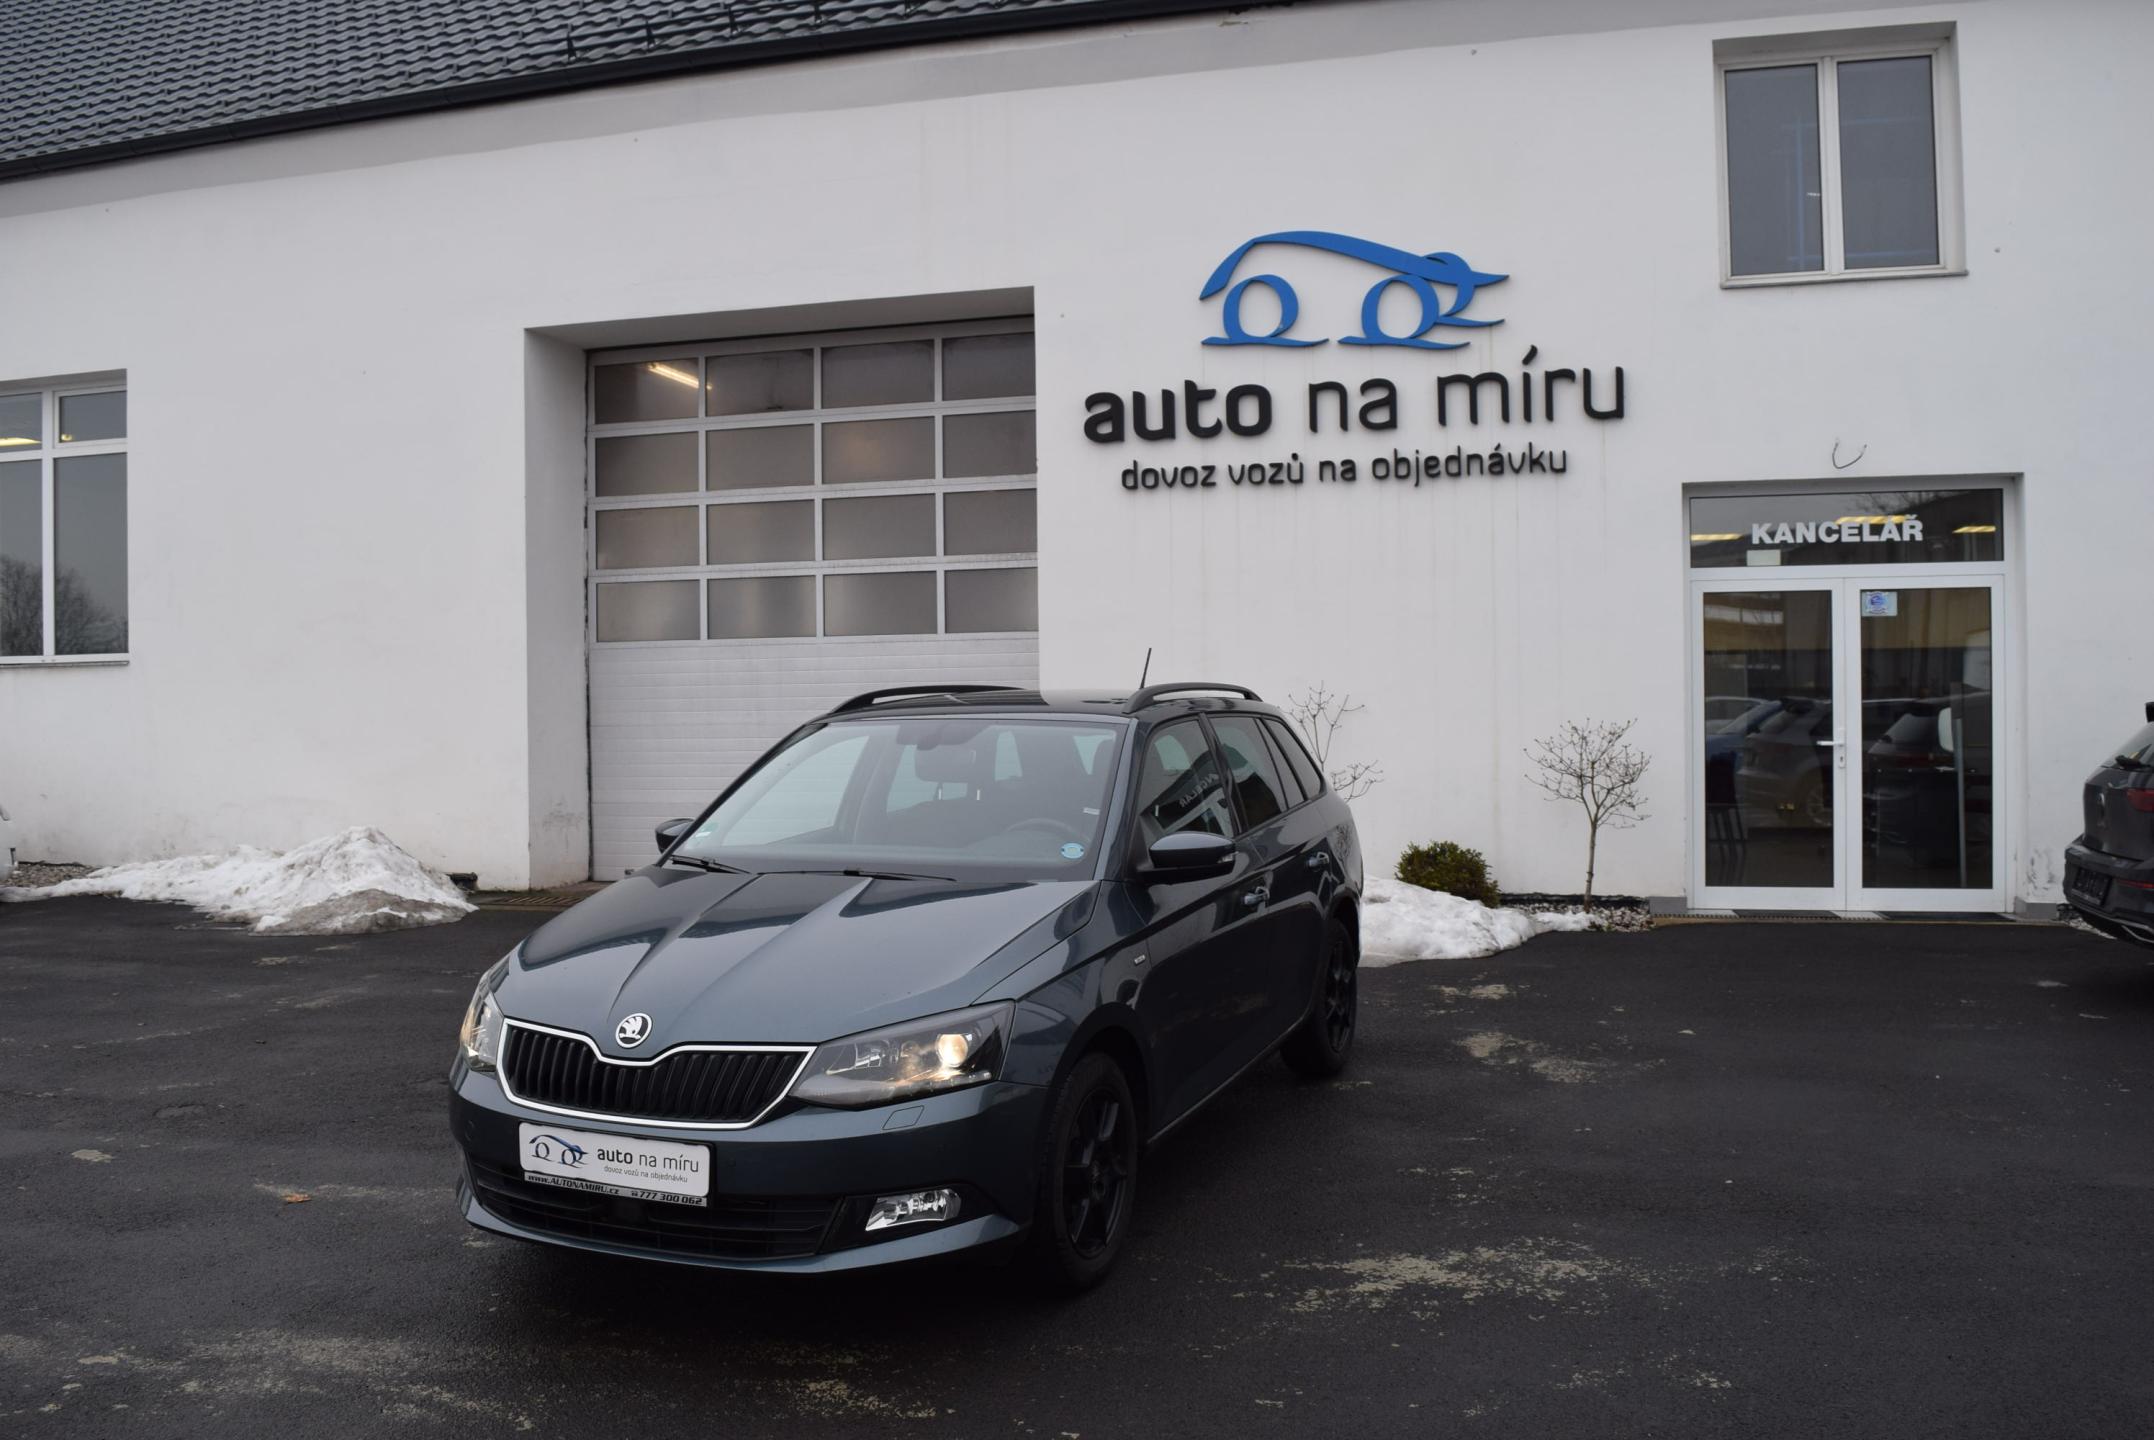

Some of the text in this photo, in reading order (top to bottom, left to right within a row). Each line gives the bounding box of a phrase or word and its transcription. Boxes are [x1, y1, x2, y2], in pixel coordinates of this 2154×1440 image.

[1083, 345, 1626, 444] auto na míru
[1121, 442, 1568, 491] dovoz vozů na objednávku
[597, 1148, 699, 1172] auto na míru
[603, 1165, 622, 1174] dovoz
[639, 1190, 658, 1200] 777
[660, 1193, 680, 1203] 300
